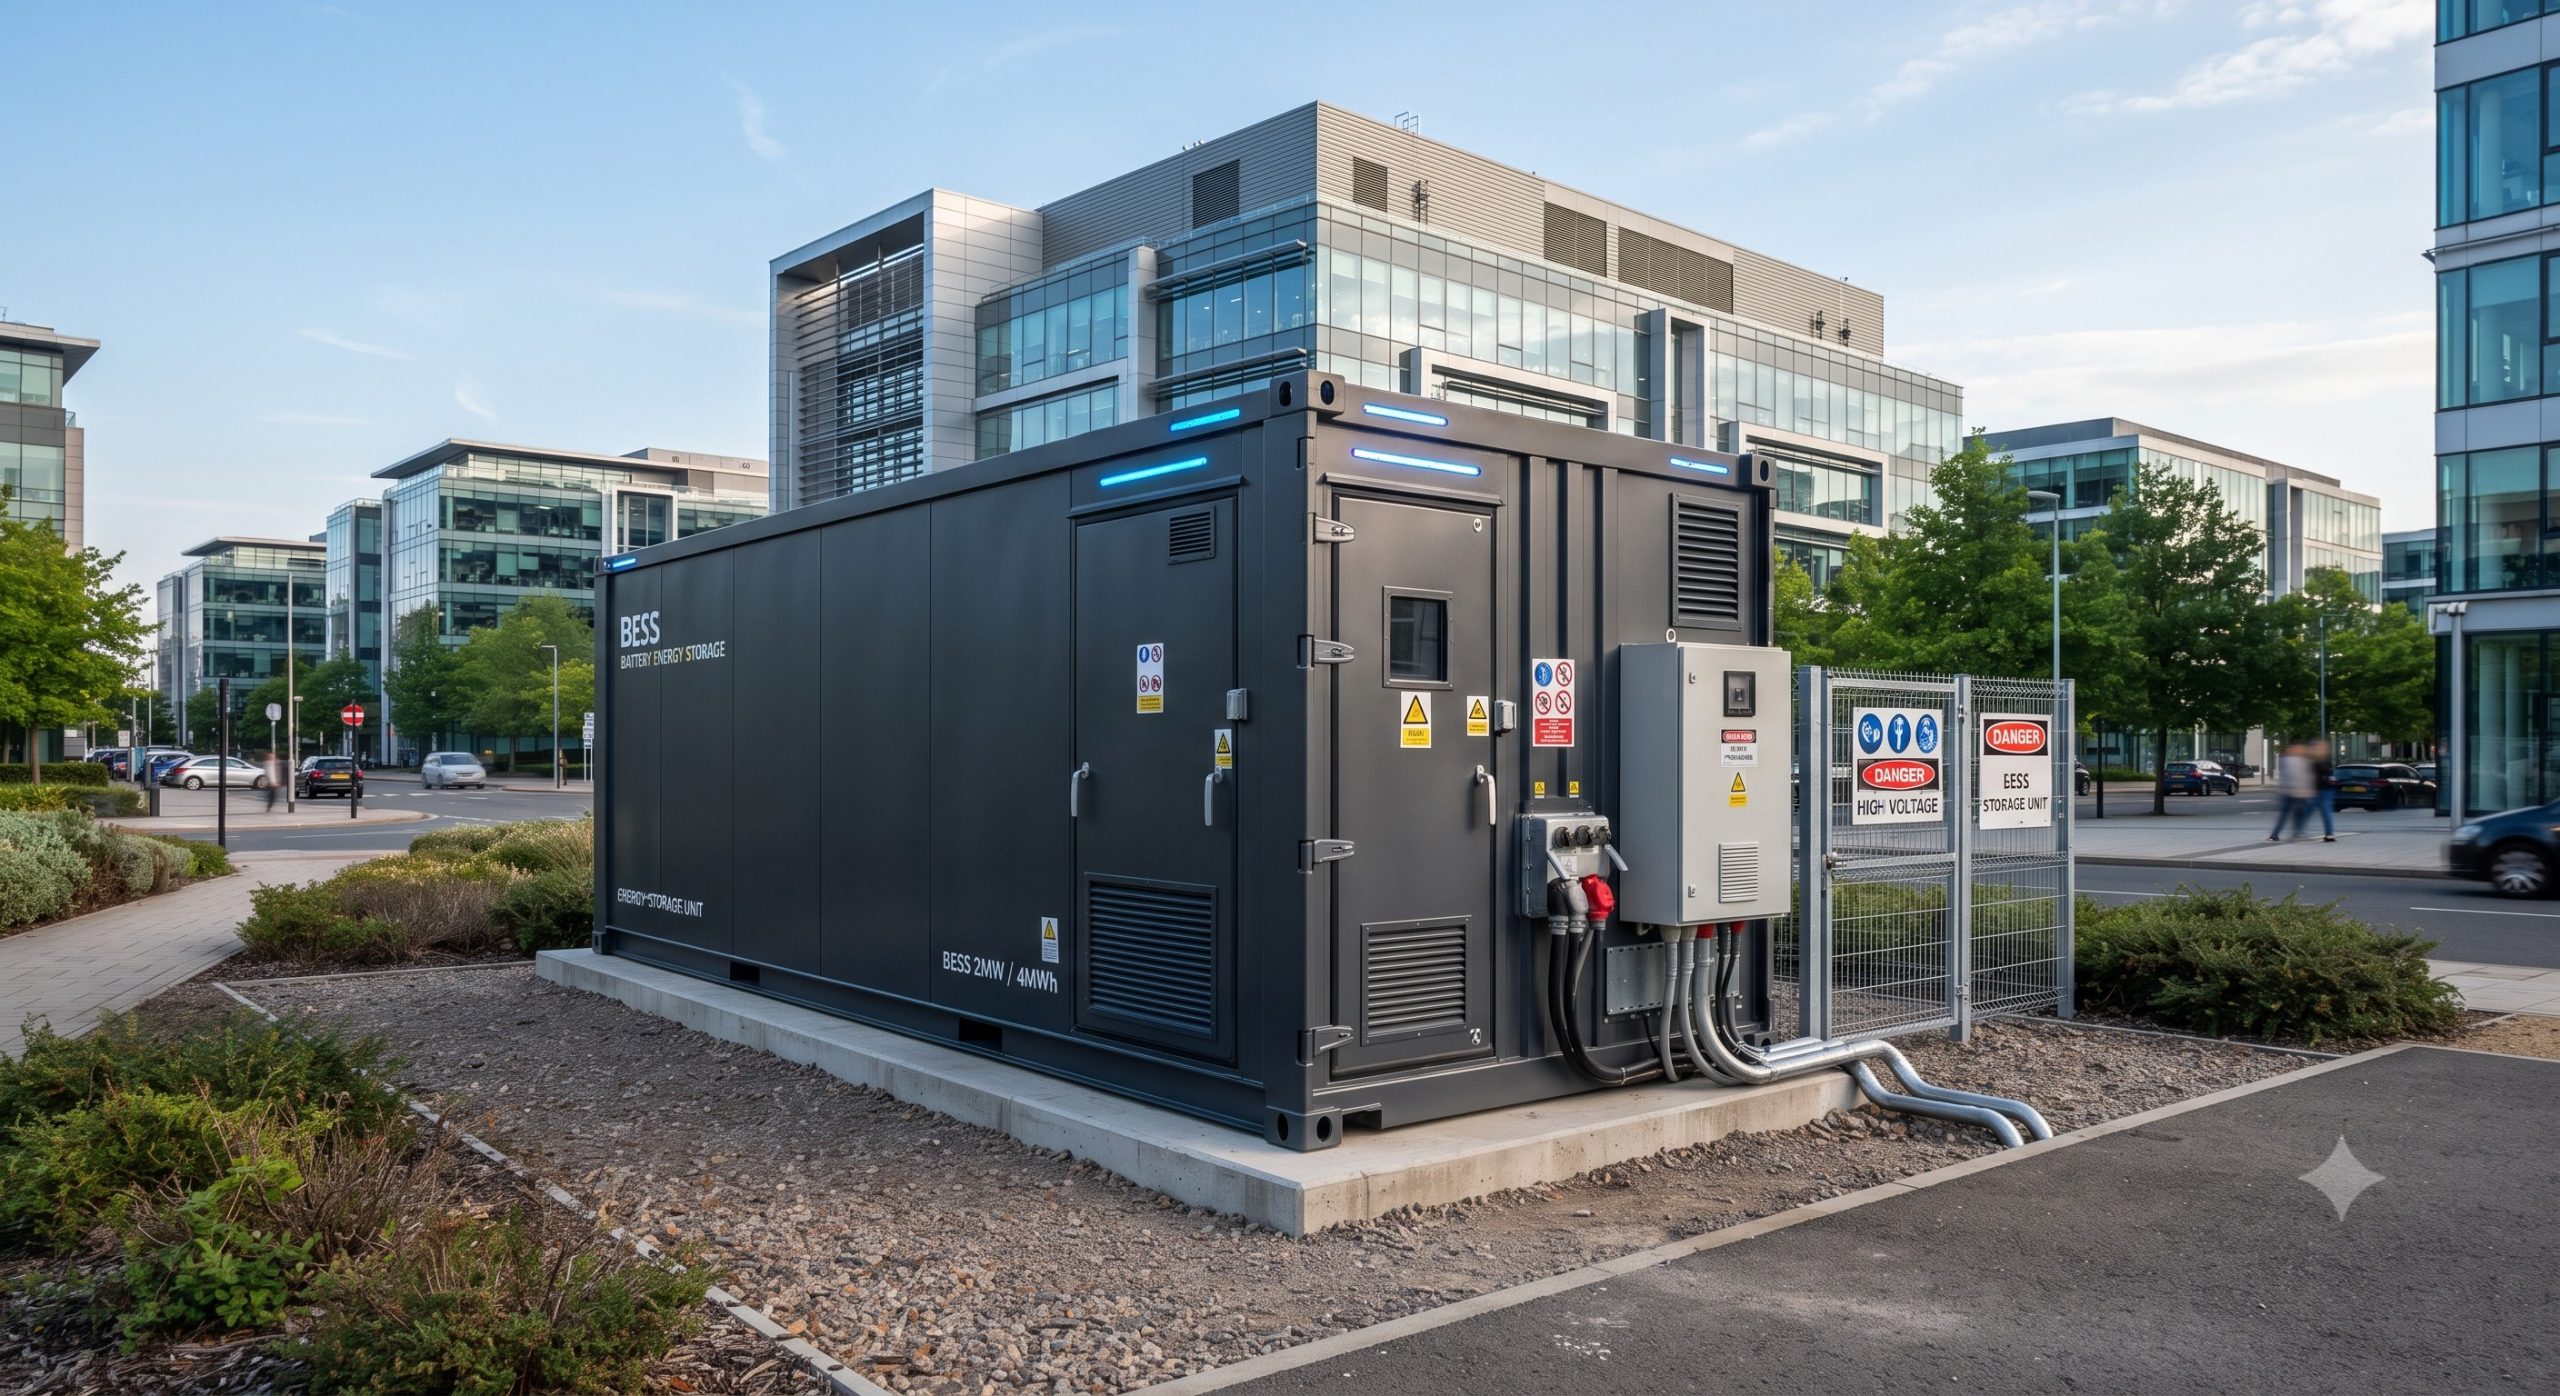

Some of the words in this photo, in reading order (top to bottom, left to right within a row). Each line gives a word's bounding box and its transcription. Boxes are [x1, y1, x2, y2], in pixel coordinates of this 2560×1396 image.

[620, 610, 661, 648] BESS
[620, 652, 651, 670] BATTERY
[653, 646, 684, 666] ENERGY
[685, 640, 726, 662] STORAGE
[1993, 729, 2040, 744] DANGER
[1874, 767, 1925, 783] DANGER
[1889, 798, 1938, 814] VOLTAGE
[1983, 797, 2025, 812] STORAGE
[2027, 797, 2048, 810] UNIT
[684, 899, 703, 917] UNIT
[943, 950, 971, 975] BESS
[973, 956, 1005, 981] 2MW
[1006, 961, 1014, 987] /
[1016, 966, 1058, 994] 4MWh
